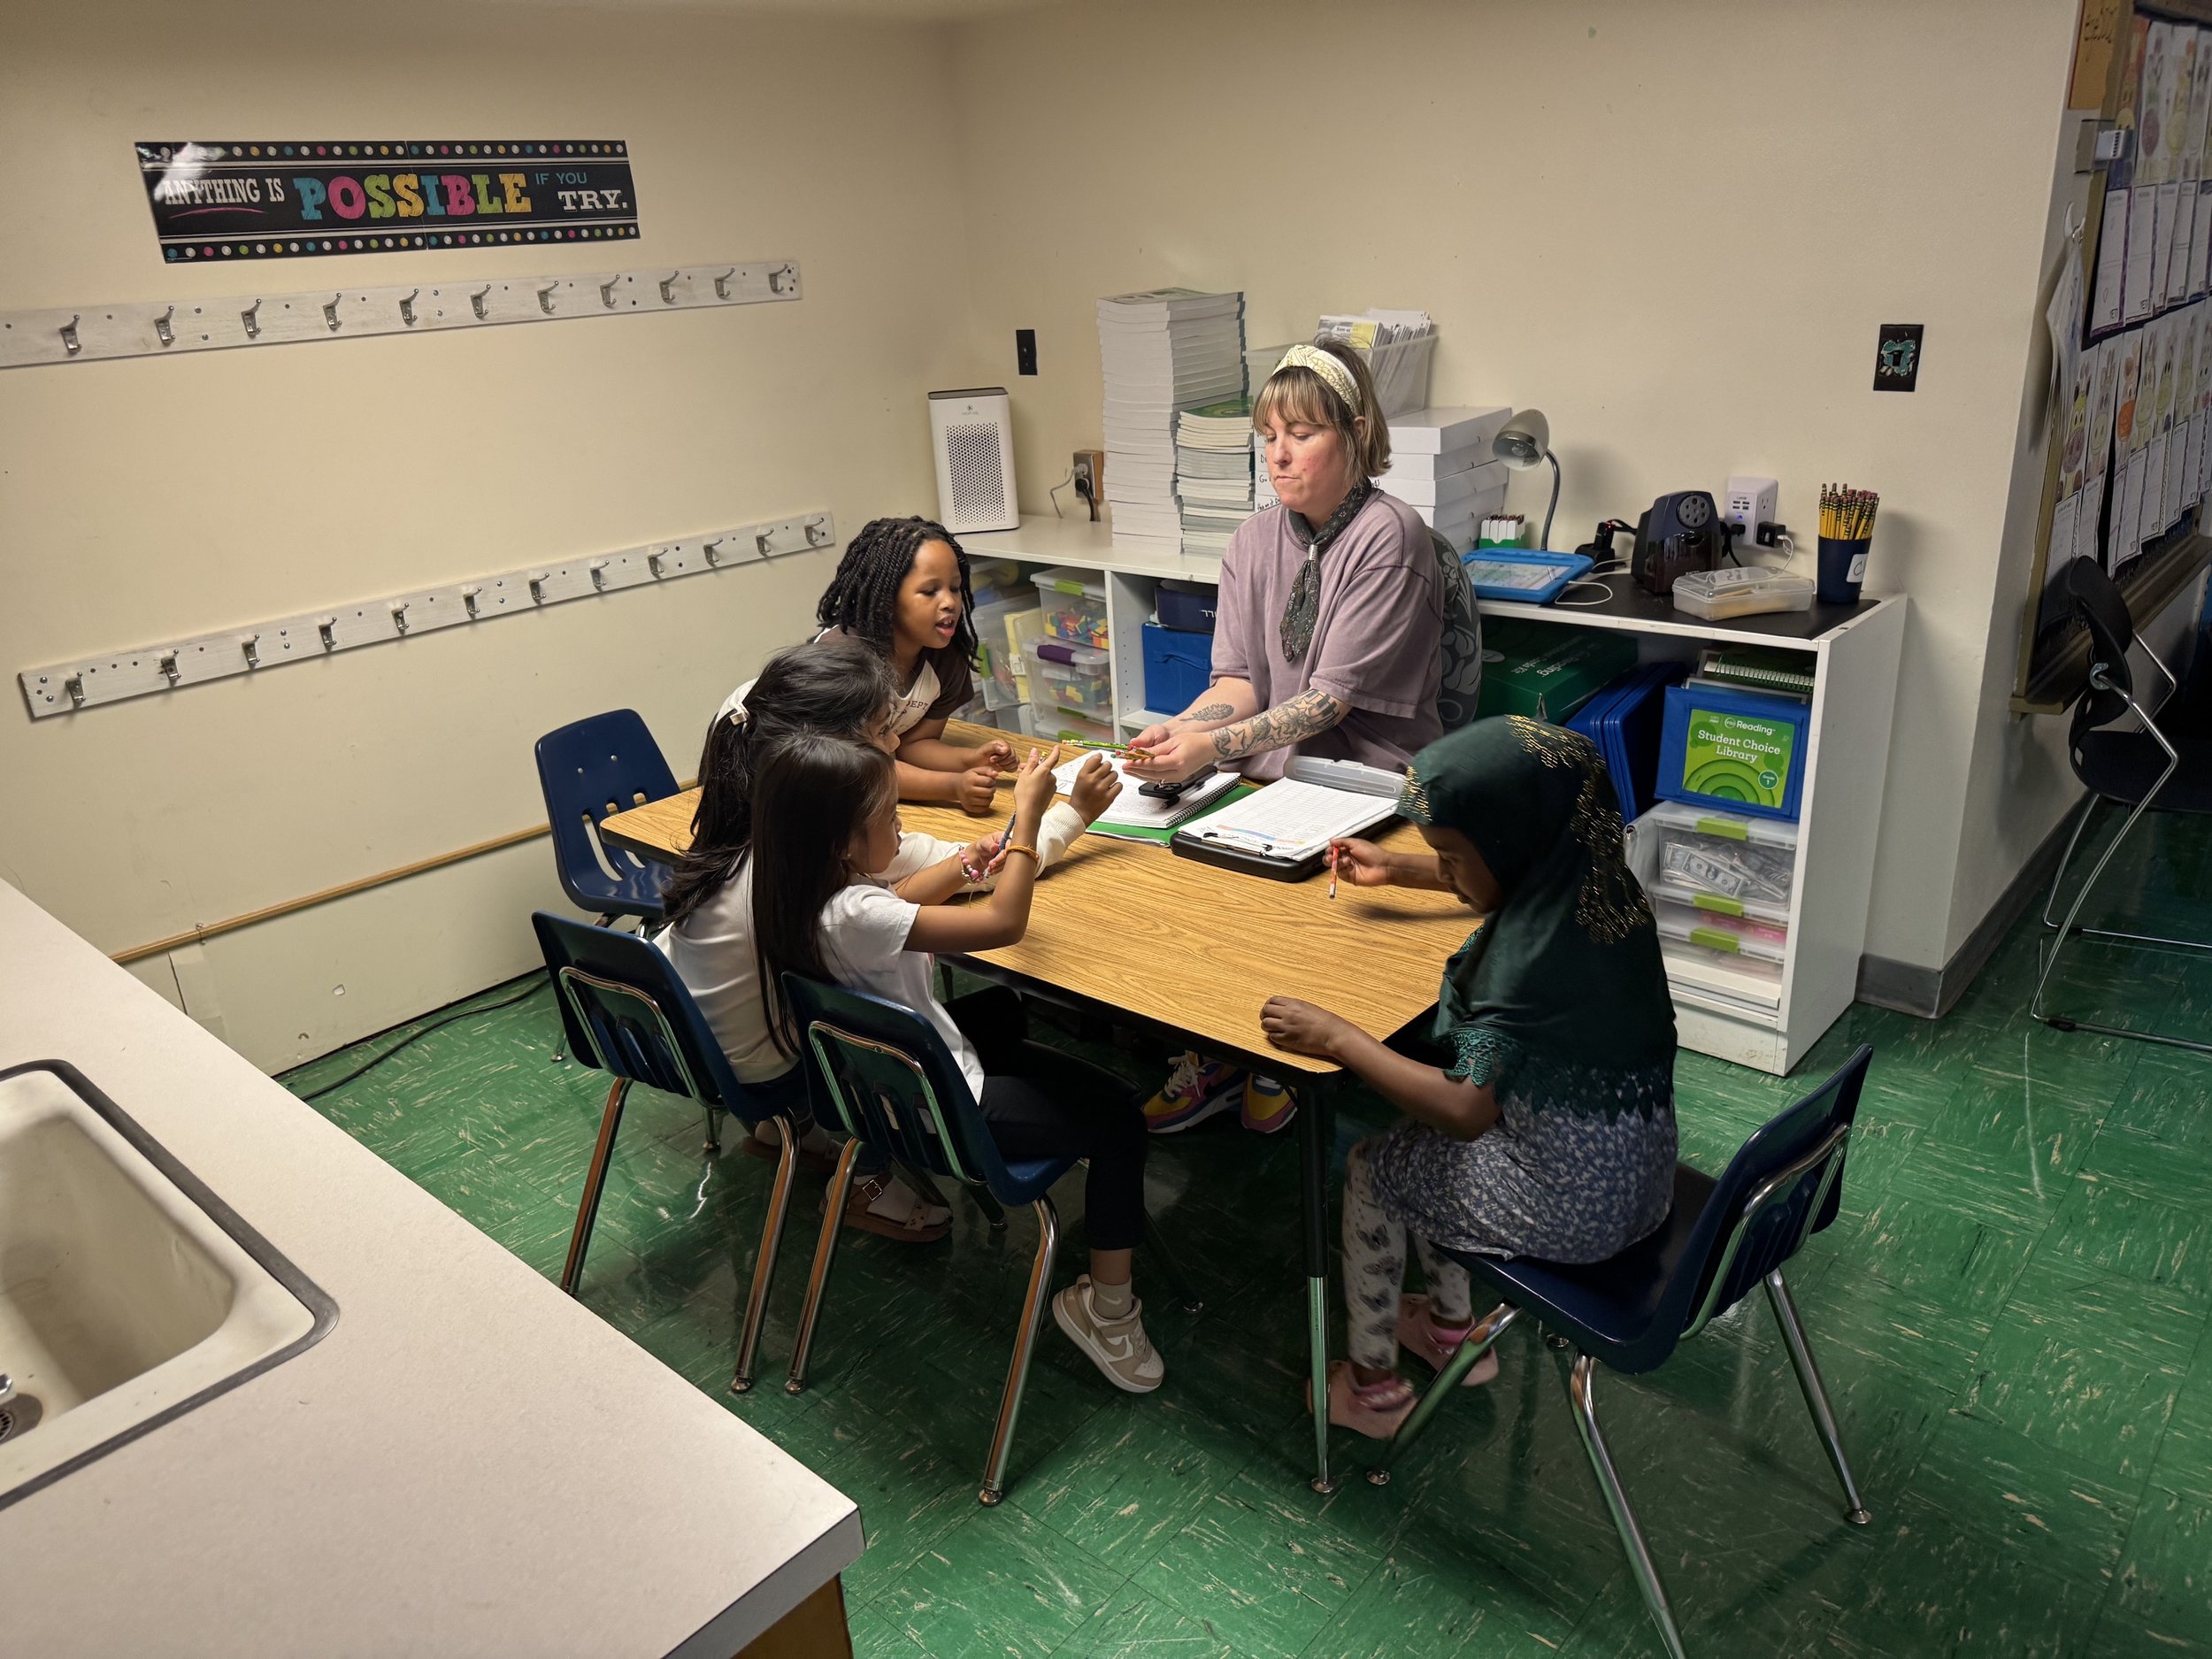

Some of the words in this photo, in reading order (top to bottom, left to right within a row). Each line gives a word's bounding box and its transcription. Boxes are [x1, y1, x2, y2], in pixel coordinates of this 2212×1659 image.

[534, 173, 549, 185] IF
[556, 172, 588, 184] YOU
[163, 178, 262, 204] ANYTHING
[265, 177, 286, 203] IS
[293, 173, 532, 219] POSSIBLE
[557, 189, 628, 211] TRY.
[1736, 720, 1773, 735] Reading
[1697, 730, 1740, 747] Student
[1742, 739, 1781, 755] Choice
[1716, 745, 1758, 764] Library
